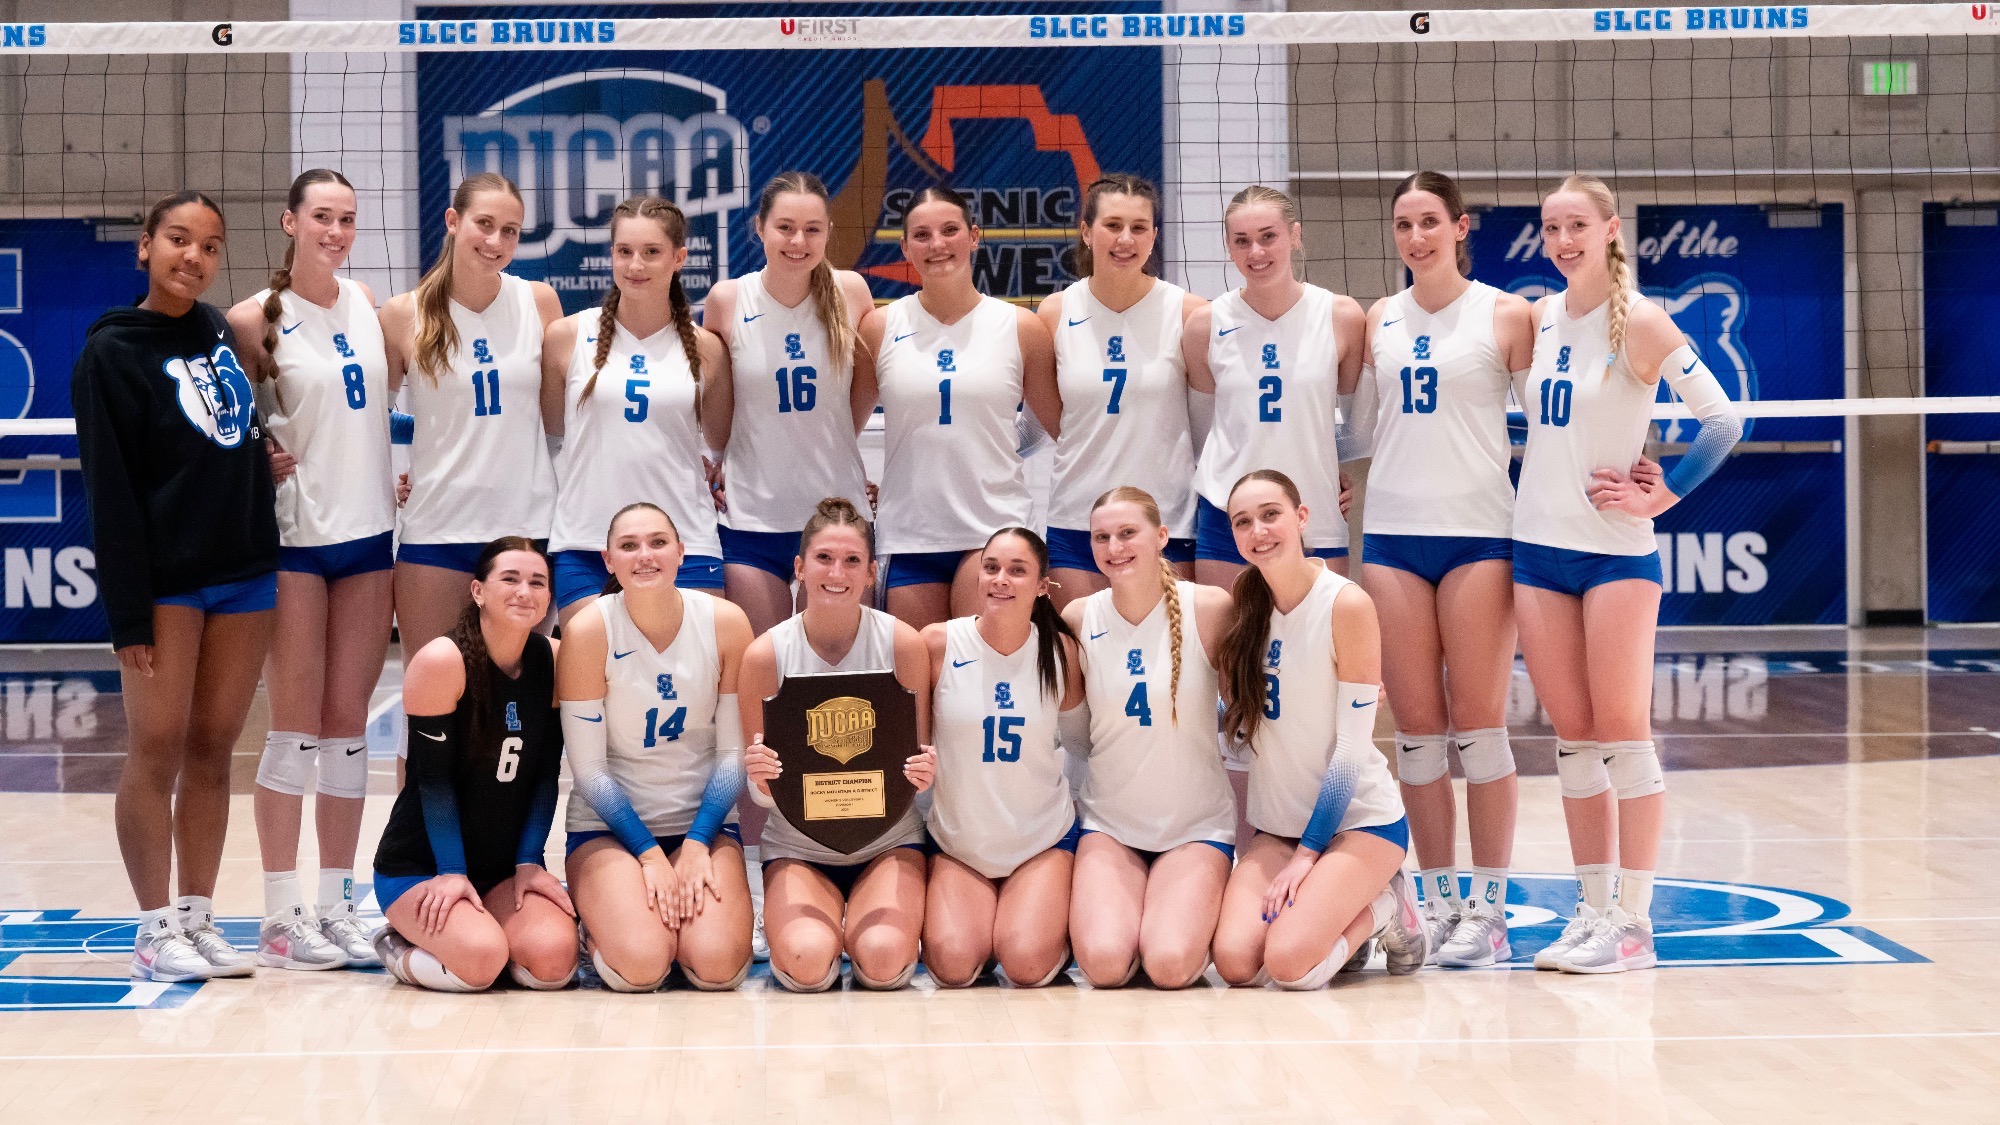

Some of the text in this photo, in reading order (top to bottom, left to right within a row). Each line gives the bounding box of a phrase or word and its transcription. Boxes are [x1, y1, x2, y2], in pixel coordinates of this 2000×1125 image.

[0, 25, 46, 48] NS
[398, 21, 615, 44] SLCC BRUINS
[1030, 15, 1245, 38] SLCC BRUINS
[1594, 8, 1809, 32] SLCC BRUINS
[341, 363, 367, 411] 8
[471, 369, 502, 417] 11
[623, 378, 651, 423] 5
[775, 365, 817, 413] 16
[938, 378, 952, 425] 1
[1102, 368, 1128, 415] 7
[1258, 375, 1283, 423] 2
[1399, 366, 1438, 414] 13
[1540, 378, 1574, 428] 10
[1124, 681, 1152, 727] 4
[1263, 674, 1281, 721] 3
[643, 706, 687, 748] 14
[809, 710, 873, 742] NJCAA
[982, 715, 1025, 763] 15
[496, 736, 524, 783] 6
